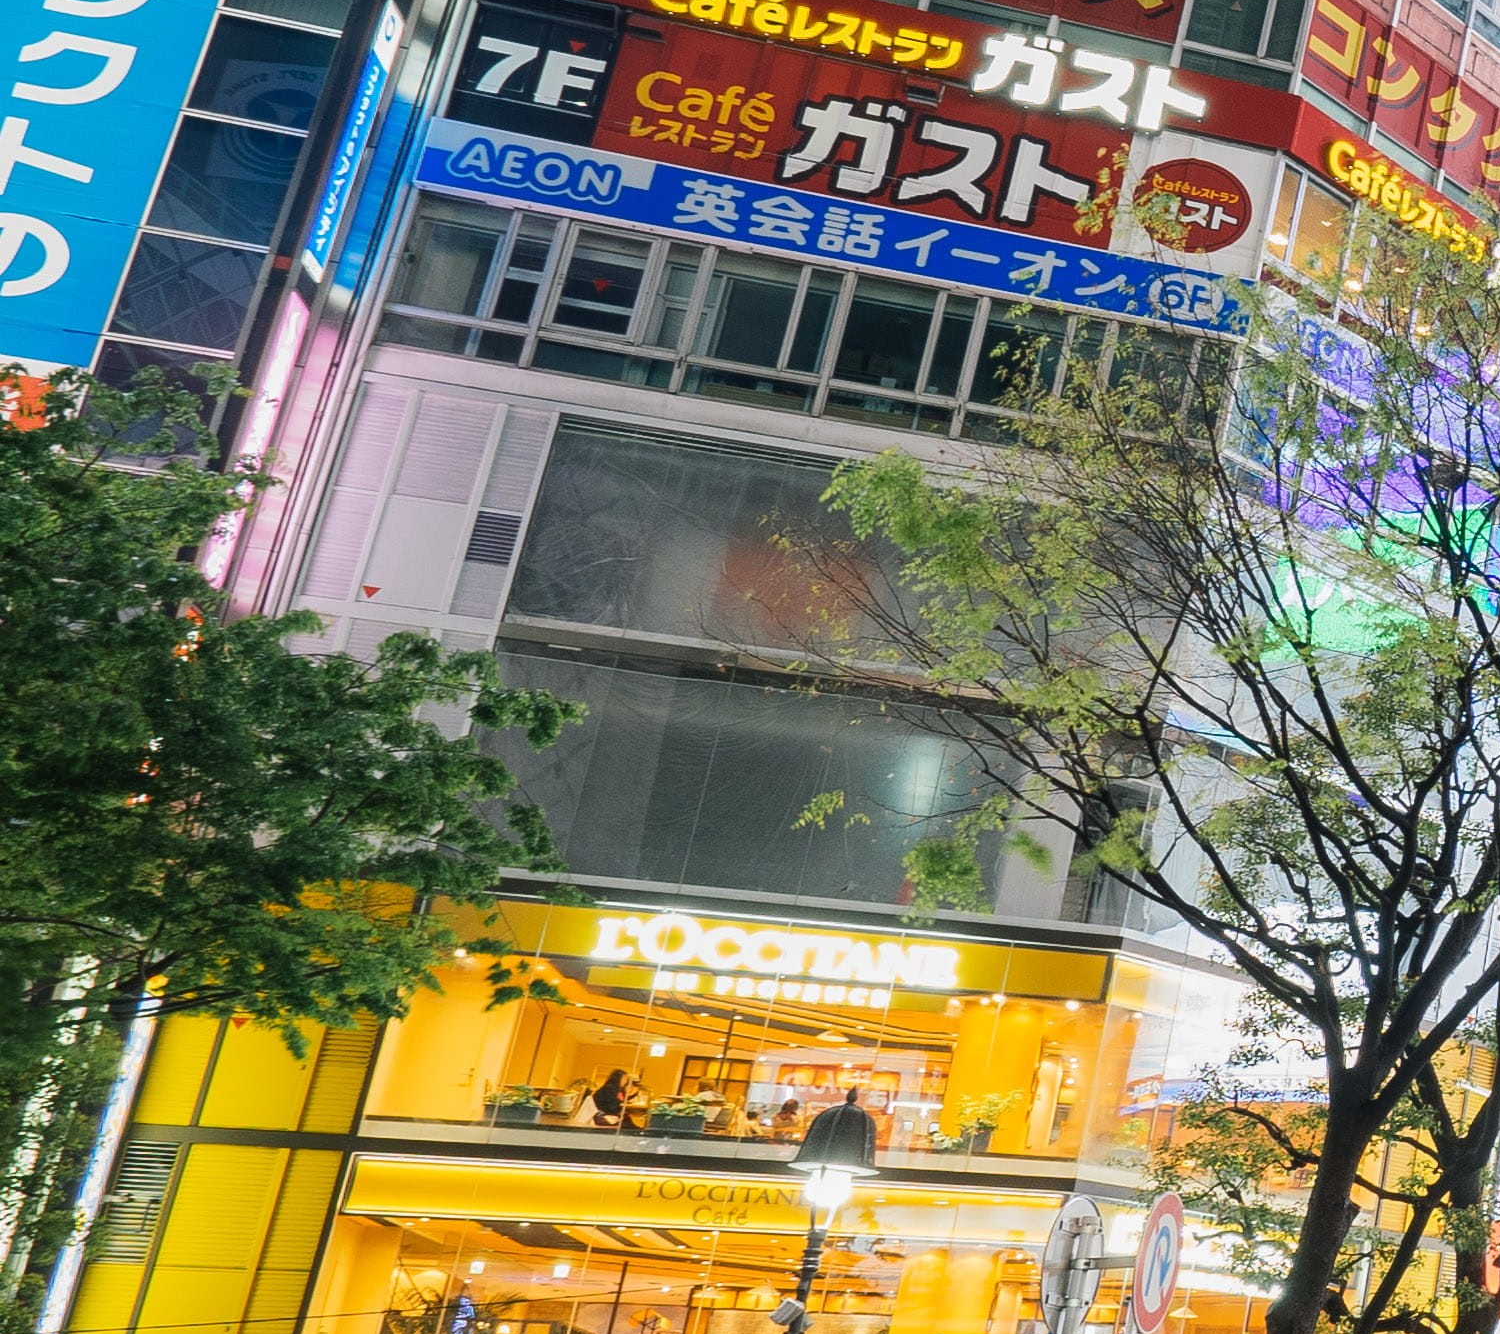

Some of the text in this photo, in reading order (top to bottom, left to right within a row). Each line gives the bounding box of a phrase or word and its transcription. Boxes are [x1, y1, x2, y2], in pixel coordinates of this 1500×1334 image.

[476, 37, 606, 107] 7F
[634, 70, 777, 130] Café
[972, 33, 1208, 131] ガスト
[628, 113, 767, 162] レストラン
[781, 97, 1094, 224] ガスト
[456, 143, 616, 202] AEON
[1162, 195, 1239, 232] スト
[673, 178, 1213, 321] 英会話イーオン 6F
[591, 913, 960, 988] L'OCCITANE
[714, 974, 892, 1009] PROVENCE
[634, 1179, 806, 1207] L'OCCITAN
[691, 1203, 750, 1228] Café
